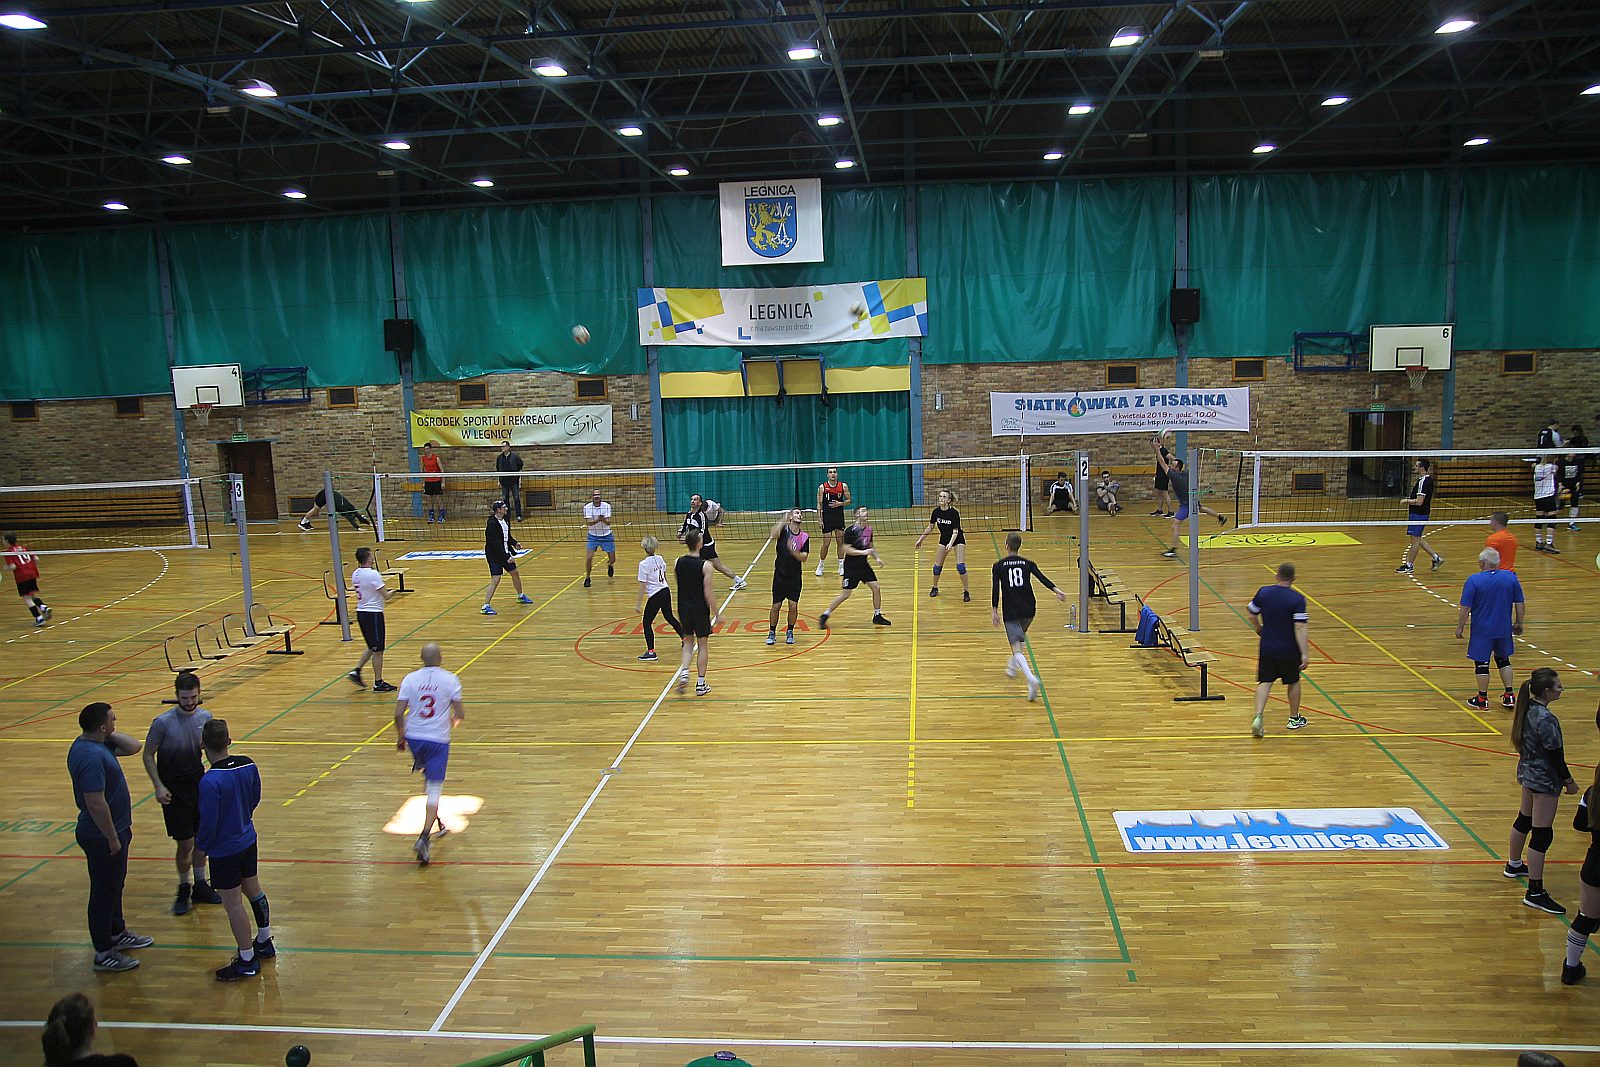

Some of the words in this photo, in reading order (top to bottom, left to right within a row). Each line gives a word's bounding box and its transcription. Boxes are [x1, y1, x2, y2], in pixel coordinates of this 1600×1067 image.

[744, 185, 796, 197] LEGNICA
[749, 303, 813, 320] LEGNICA
[794, 323, 814, 331] drodze
[1443, 328, 1449, 338] 6
[231, 367, 238, 377] 4
[1135, 396, 1144, 407] Z
[1150, 394, 1228, 407] PISANKĄ
[417, 414, 460, 427] OŚRODEK
[463, 415, 500, 427] SPORTU
[502, 416, 506, 425] I
[508, 414, 557, 425] REKREACJI
[1147, 411, 1168, 419] 2019
[461, 430, 471, 439] W
[474, 429, 513, 439] LEGNICY
[1082, 461, 1087, 476] 2
[236, 483, 241, 497] 3
[1008, 567, 1023, 587] 18
[419, 693, 435, 718] 3
[1134, 832, 1436, 850] www.legnica.eu
